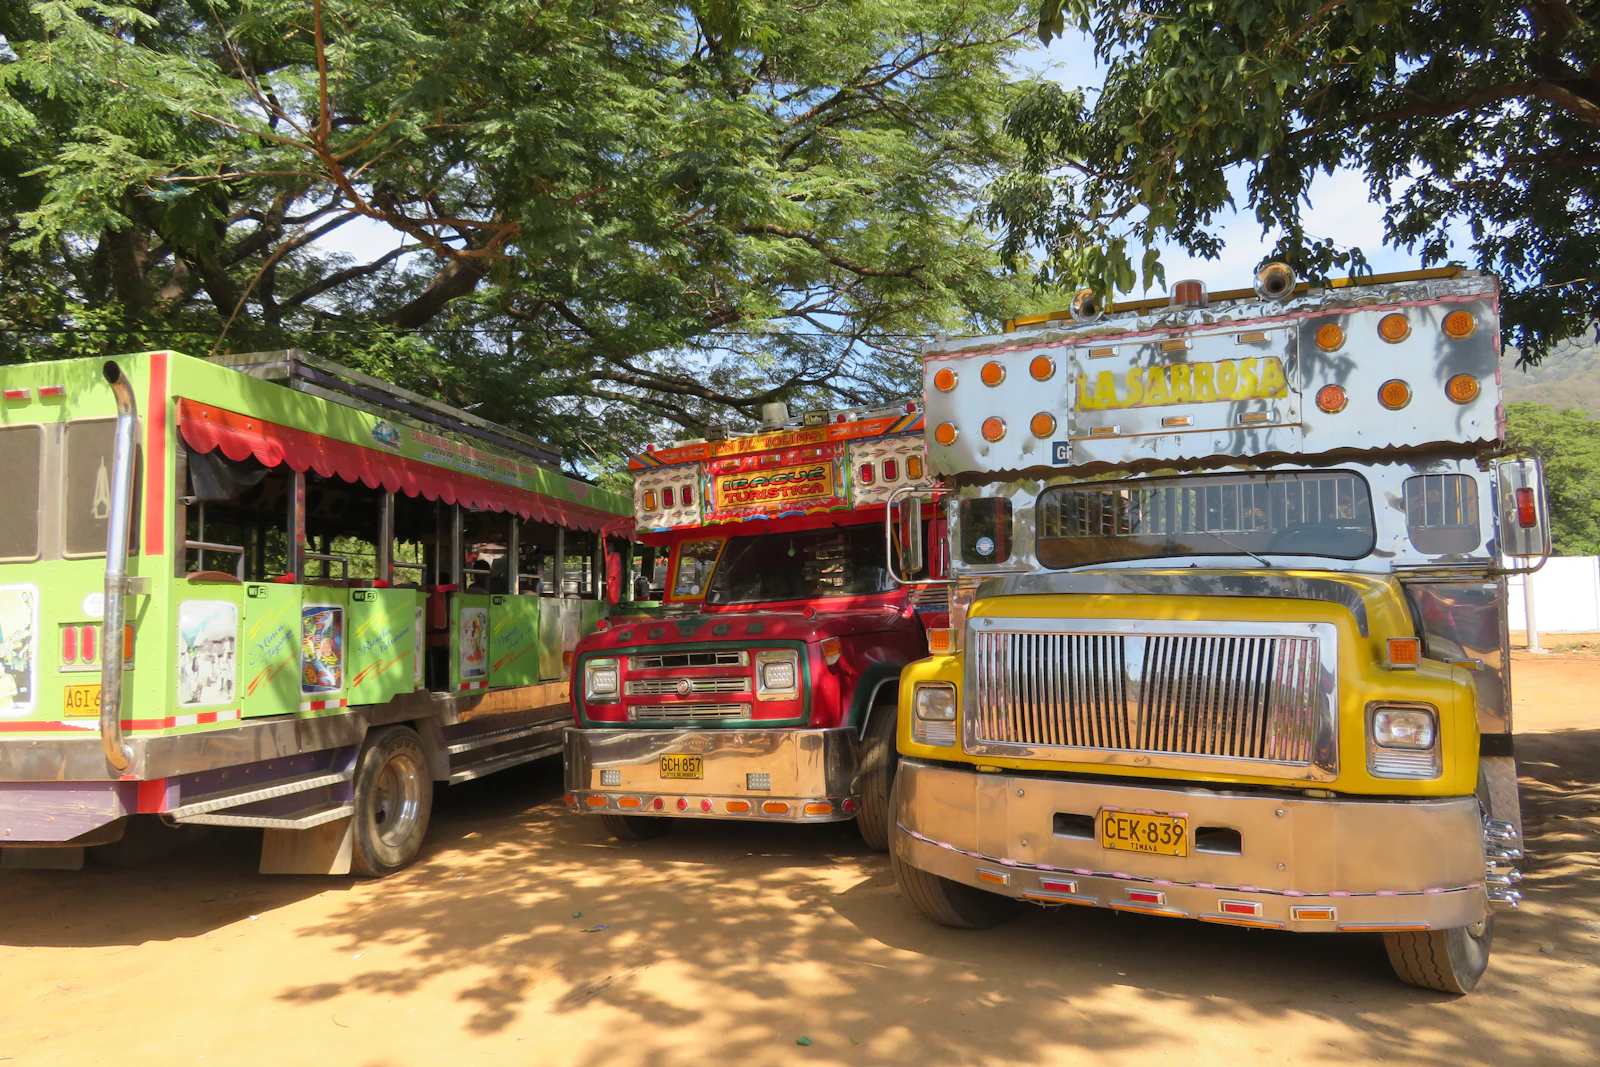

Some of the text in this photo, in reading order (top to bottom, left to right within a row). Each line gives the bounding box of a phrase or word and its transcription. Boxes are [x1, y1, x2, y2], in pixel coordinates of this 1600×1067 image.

[1075, 355, 1289, 413] LA SABROSA
[411, 428, 453, 452] EXCURSIONES
[715, 430, 823, 455] EN EL TOLIMA
[722, 466, 827, 492] IBAGUÉ
[724, 482, 825, 504] TURISTICA
[250, 624, 285, 656] Minca
[376, 626, 410, 655] Palomino
[616, 621, 766, 643] DODGE
[661, 758, 701, 772] GCH 857
